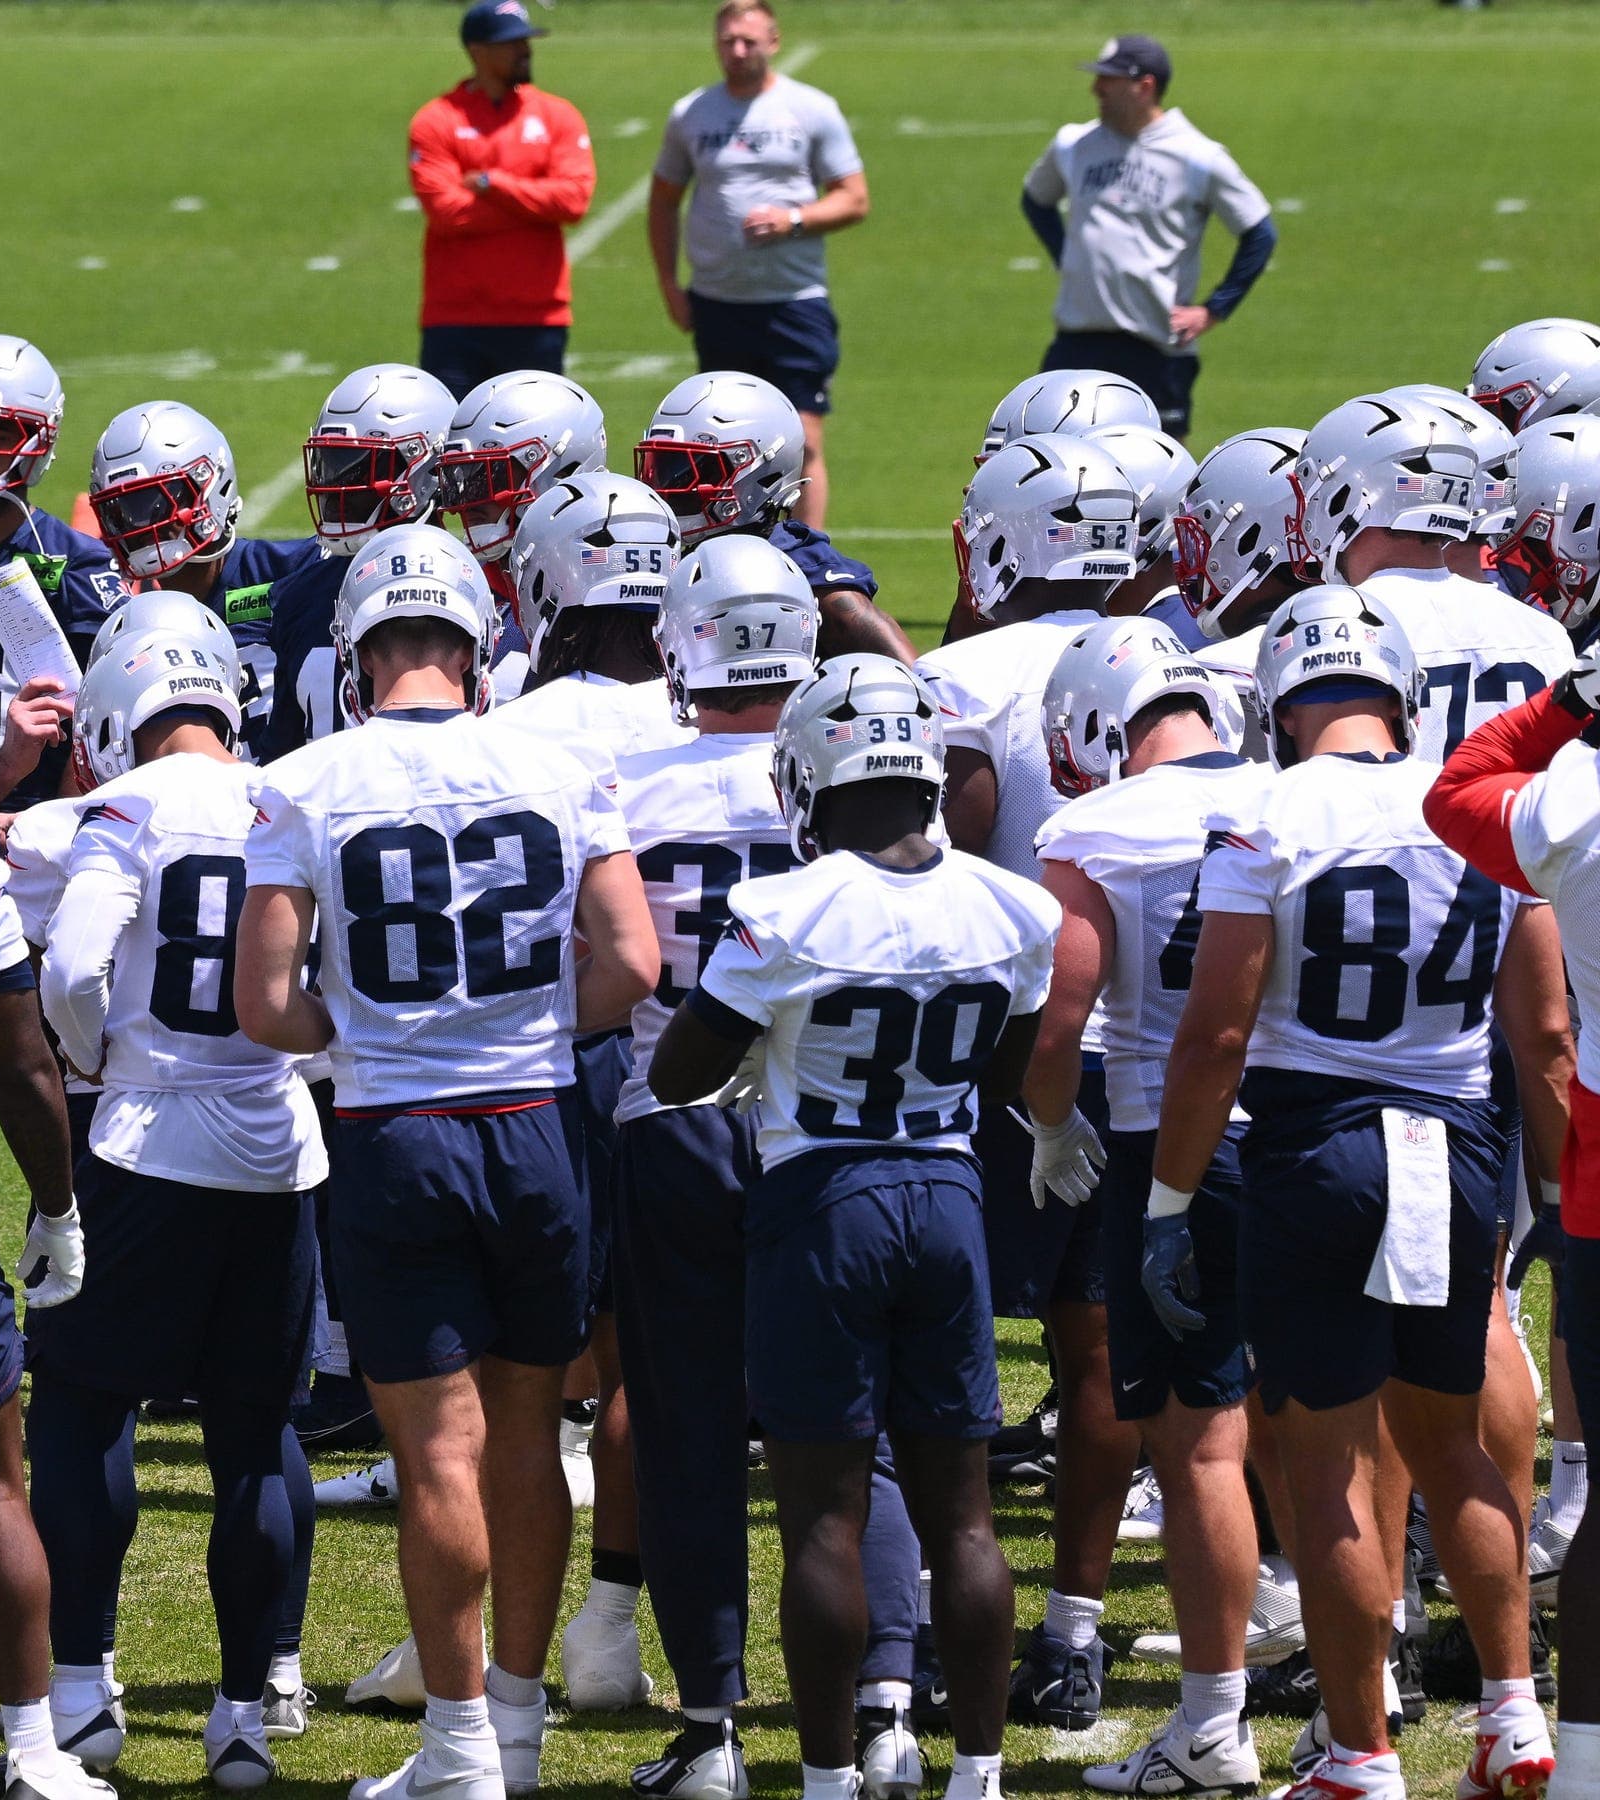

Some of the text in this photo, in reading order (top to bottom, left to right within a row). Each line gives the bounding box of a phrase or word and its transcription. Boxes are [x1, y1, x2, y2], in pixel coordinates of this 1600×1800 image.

[1441, 478, 1469, 506] 72
[1091, 525, 1127, 549] 52
[390, 554, 434, 576] 82
[625, 549, 662, 573] 55
[1082, 562, 1131, 576] PATRIOTS
[386, 588, 447, 606] PATRIOTS
[619, 584, 665, 599] PATRIOT
[734, 622, 776, 650] 37
[1304, 622, 1351, 647] 84
[1152, 637, 1187, 655] 46
[1302, 651, 1362, 673] PATRIOTS
[727, 663, 788, 684] PATRIOTS
[169, 676, 224, 695] PATRIOTS
[868, 717, 912, 744] 39
[866, 755, 923, 771] PATRIOTS
[340, 810, 564, 1005] 82
[1297, 864, 1502, 1042] 84
[794, 980, 1012, 1141] 39
[1146, 1768, 1178, 1782] ALPHA
